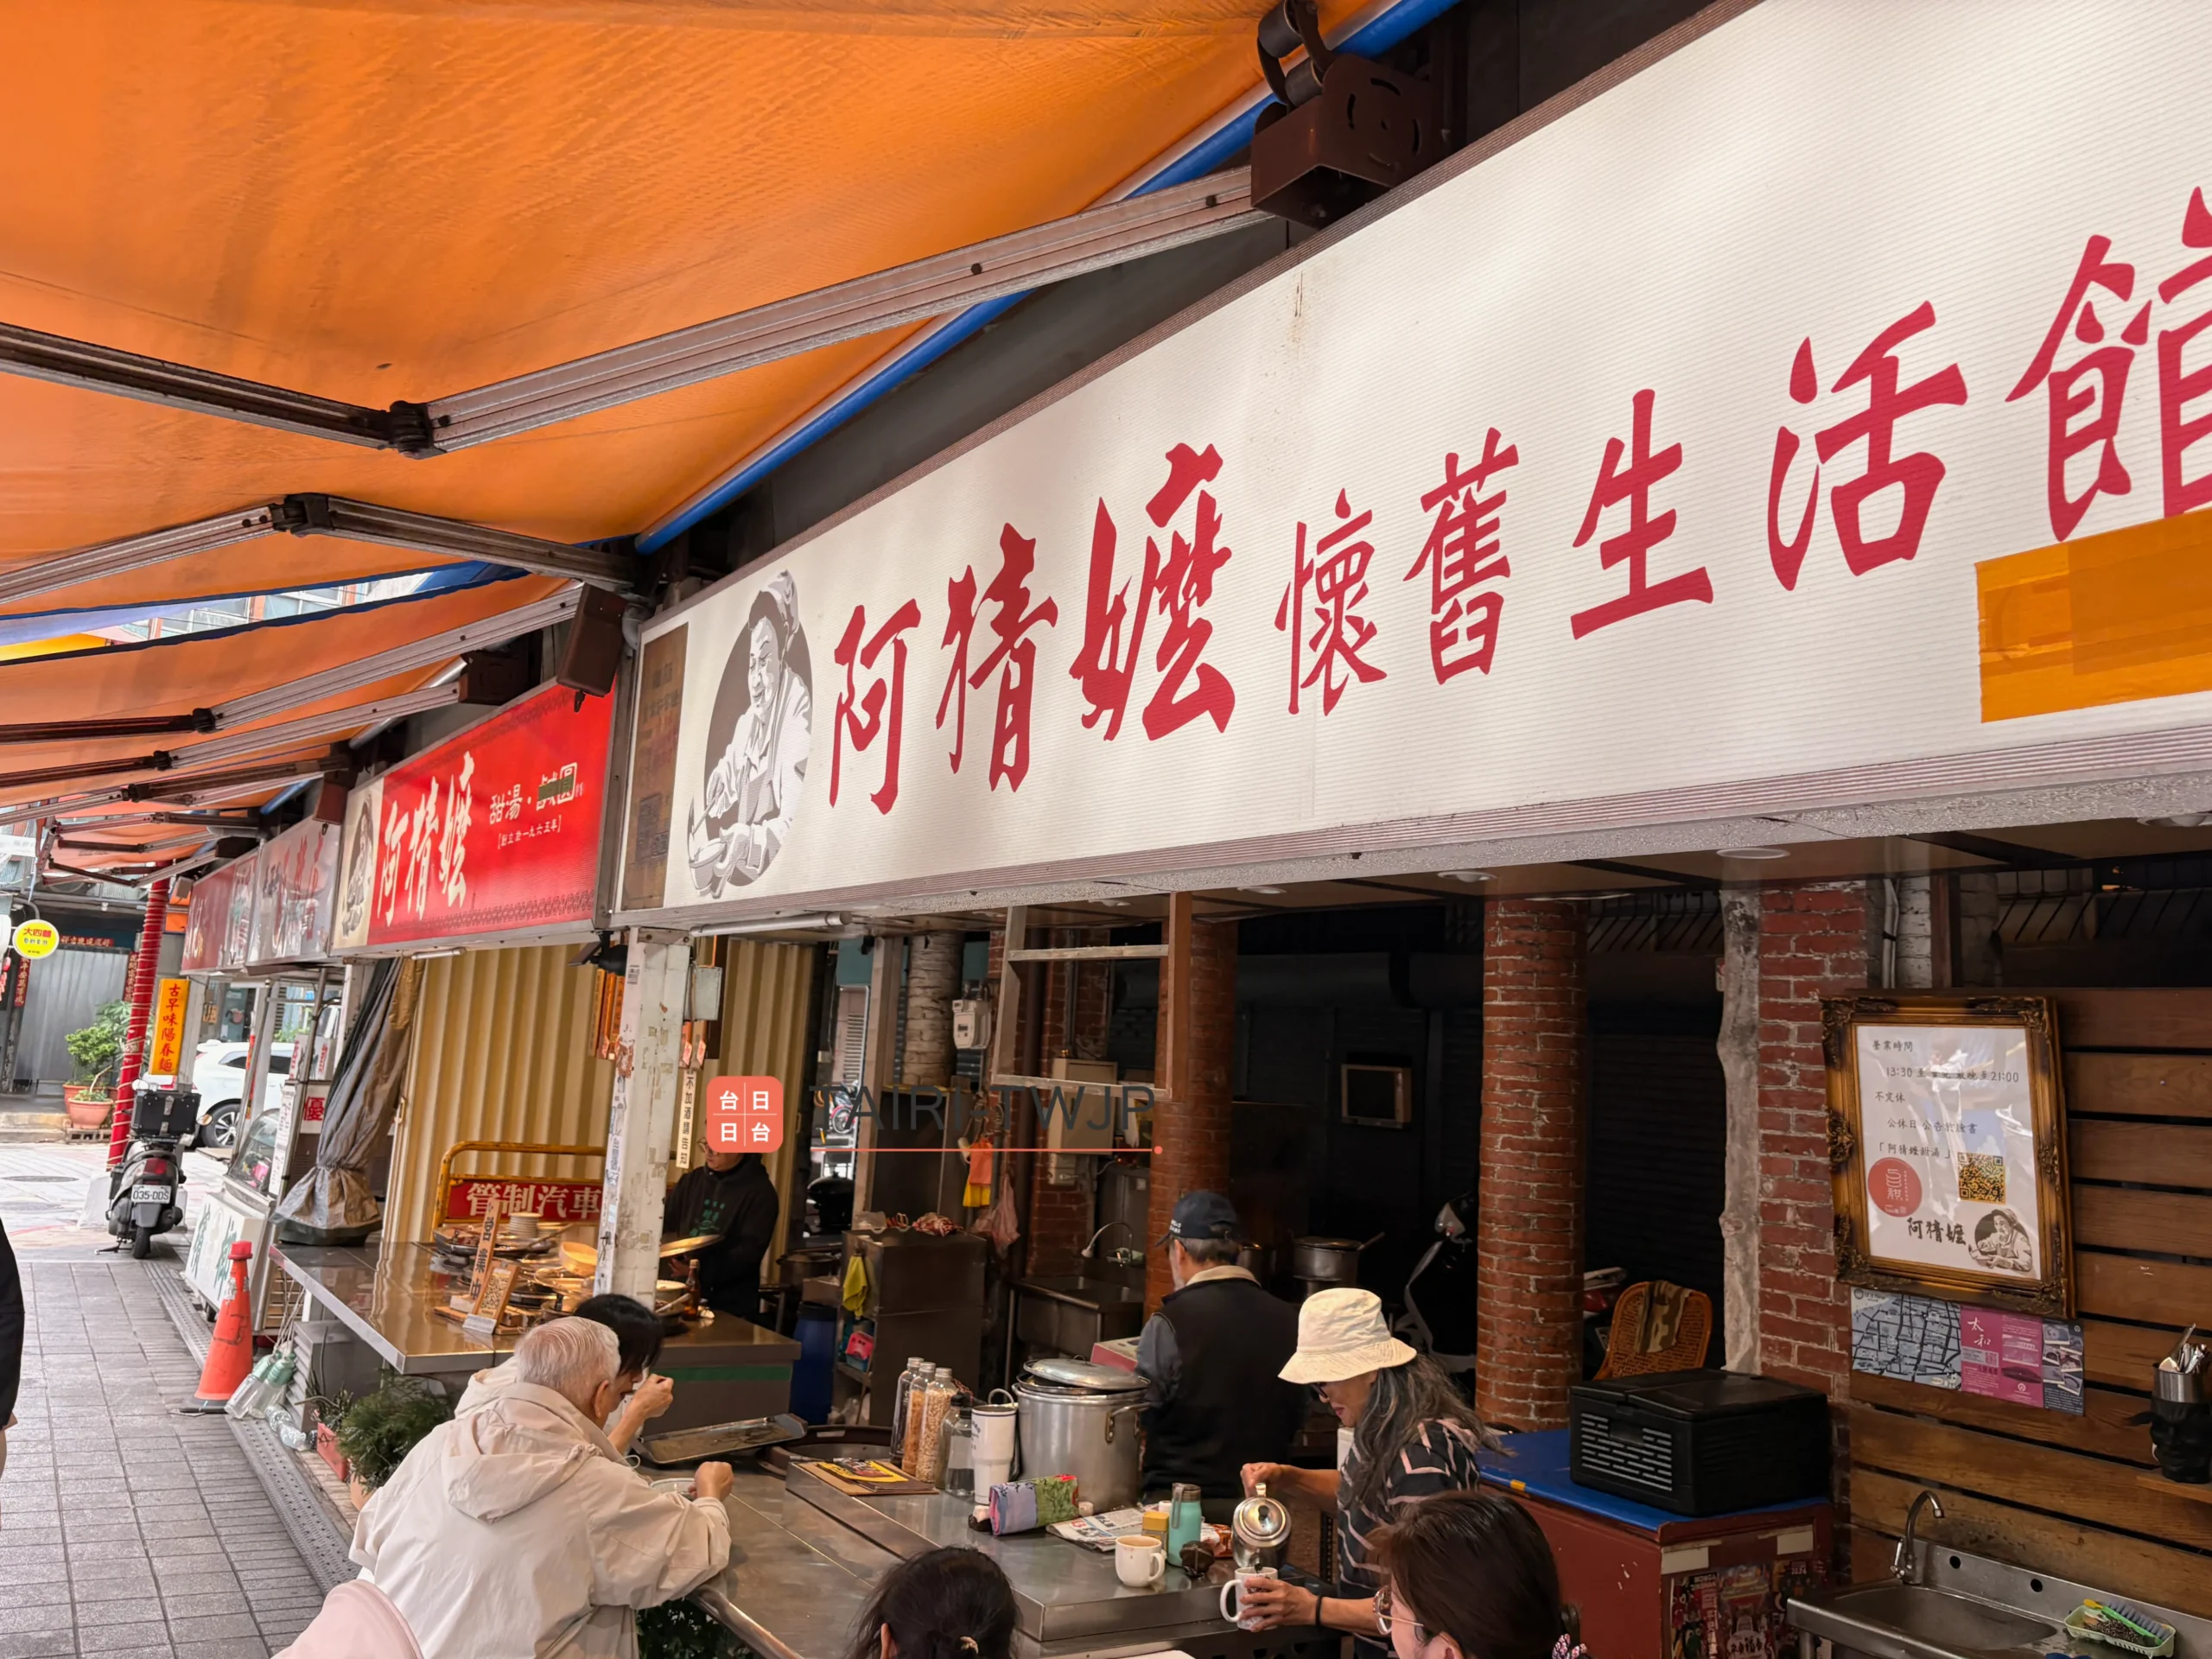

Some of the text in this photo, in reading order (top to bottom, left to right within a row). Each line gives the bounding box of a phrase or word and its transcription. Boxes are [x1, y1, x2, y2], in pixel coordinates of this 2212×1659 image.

[378, 751, 474, 926] 阿猜嬤
[160, 983, 181, 1072] 古早味陽春麵
[1872, 1040, 1913, 1052] 營業時間
[1886, 1067, 1913, 1077] 13:30
[1874, 1091, 1905, 1103] 不定休
[1886, 1119, 1916, 1129] 公休日
[132, 1190, 169, 1200] 035-DDS
[467, 1183, 602, 1219] 管制汽車
[1907, 1217, 1967, 1246] 阿猜嬤
[470, 1217, 494, 1300] 營業中
